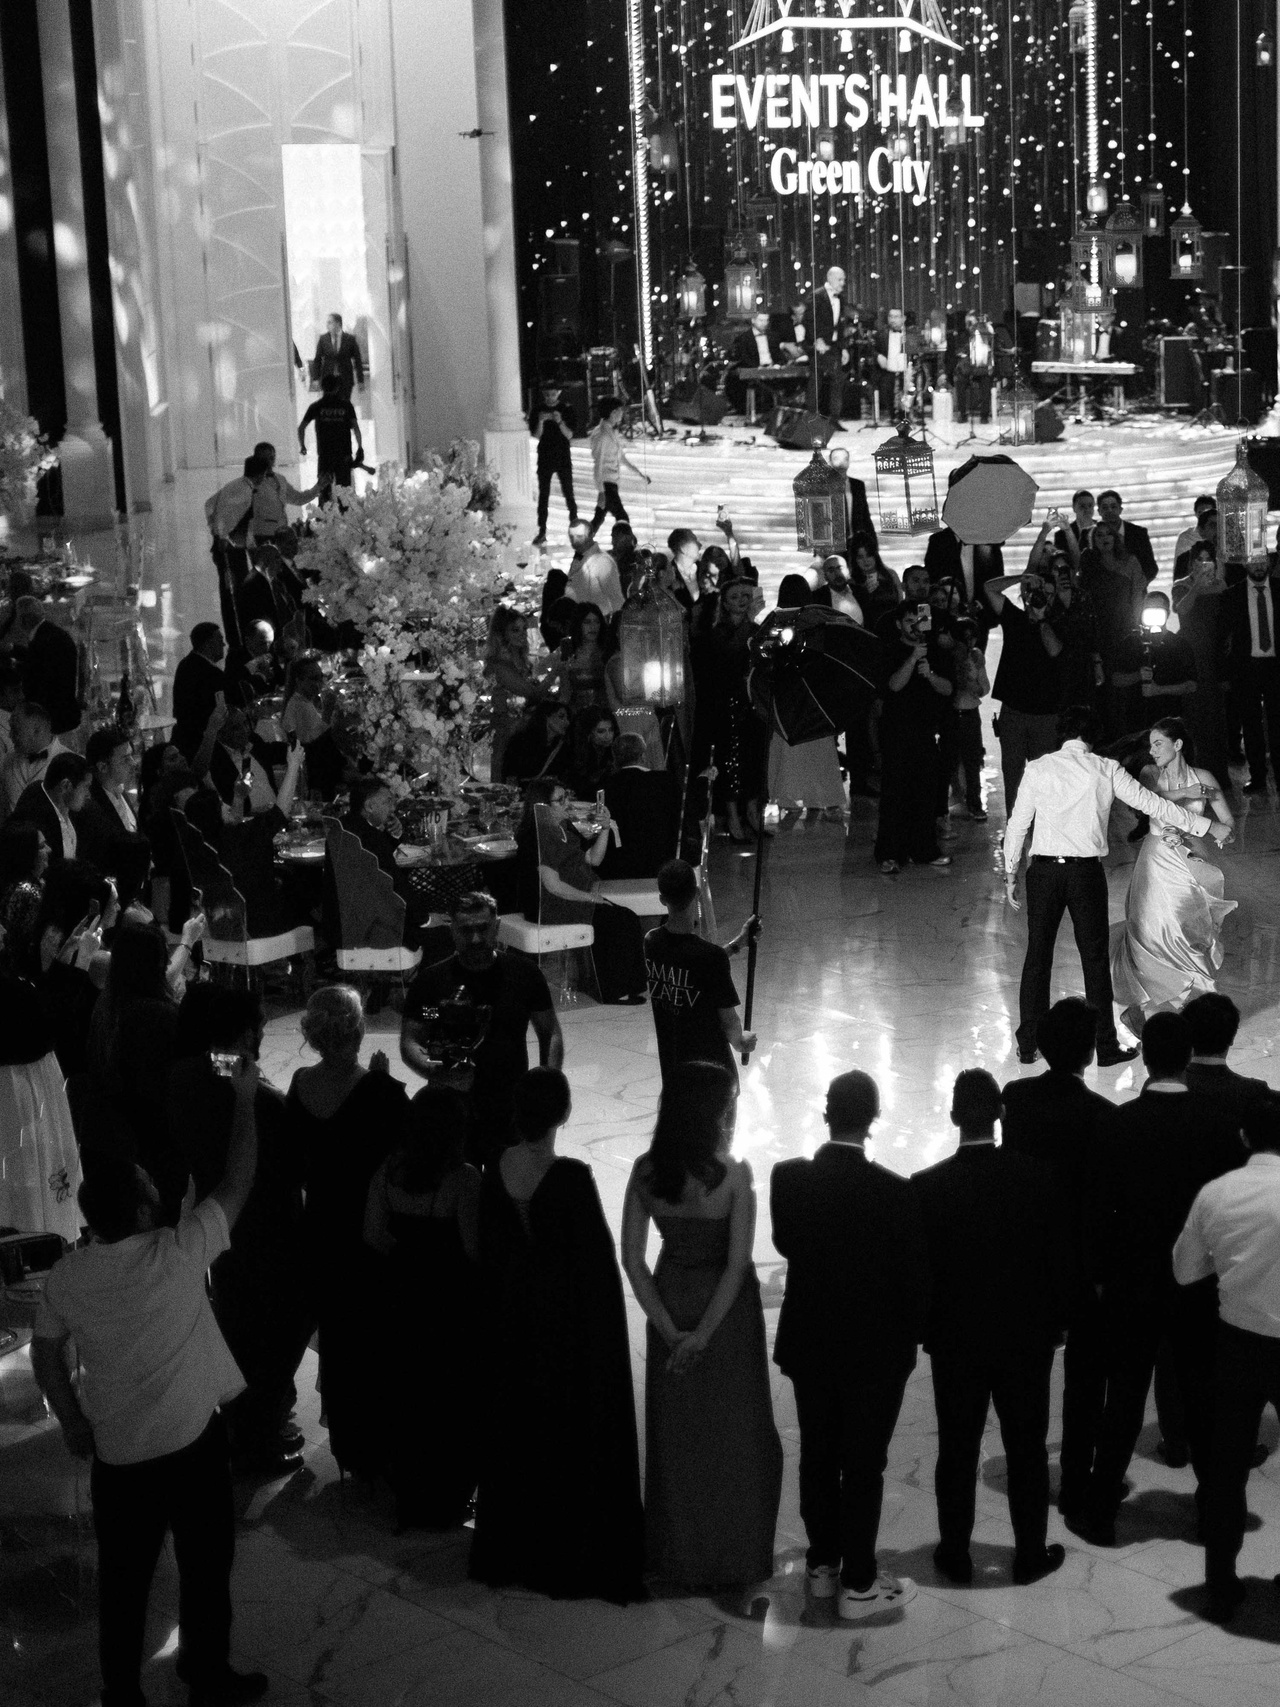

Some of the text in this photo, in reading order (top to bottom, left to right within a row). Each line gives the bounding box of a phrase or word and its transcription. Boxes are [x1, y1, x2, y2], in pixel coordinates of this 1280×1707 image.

[711, 74, 985, 128] EVENTS HALL
[770, 147, 931, 206] Green City
